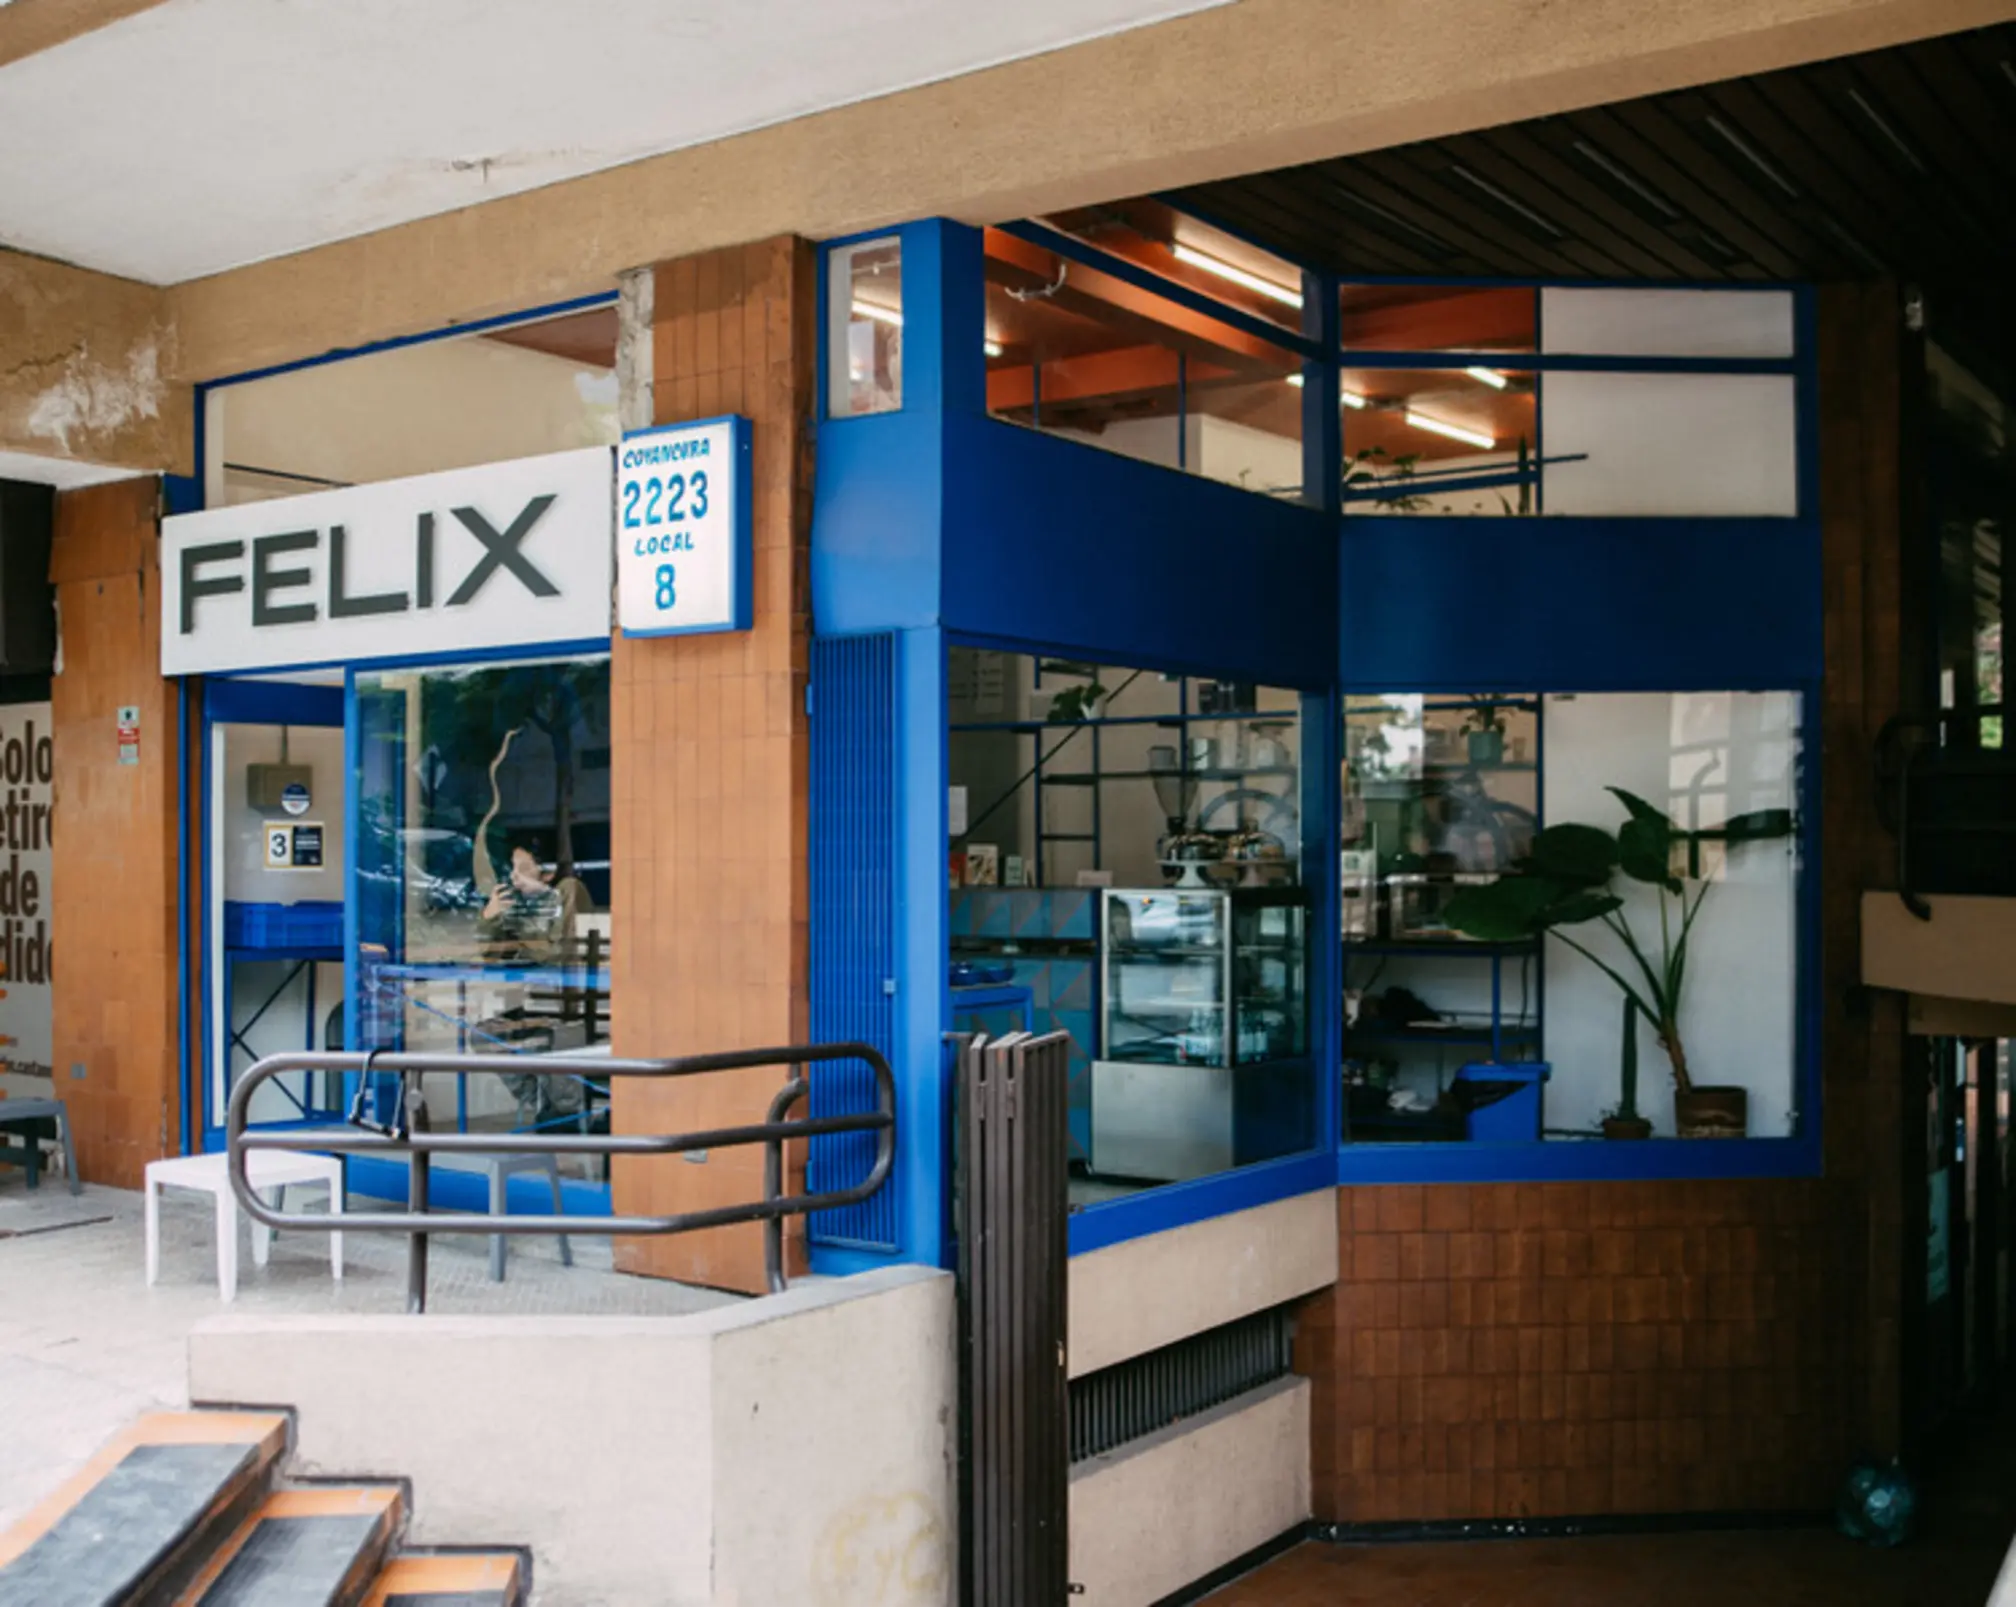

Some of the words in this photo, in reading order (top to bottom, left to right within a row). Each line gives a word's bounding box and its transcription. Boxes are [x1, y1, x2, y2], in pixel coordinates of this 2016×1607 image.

[624, 470, 708, 529] 2223
[180, 494, 562, 635] FELIX
[634, 532, 695, 556] LOCAL
[655, 563, 676, 611] 8
[0, 719, 52, 785] olo
[271, 833, 287, 858] 3
